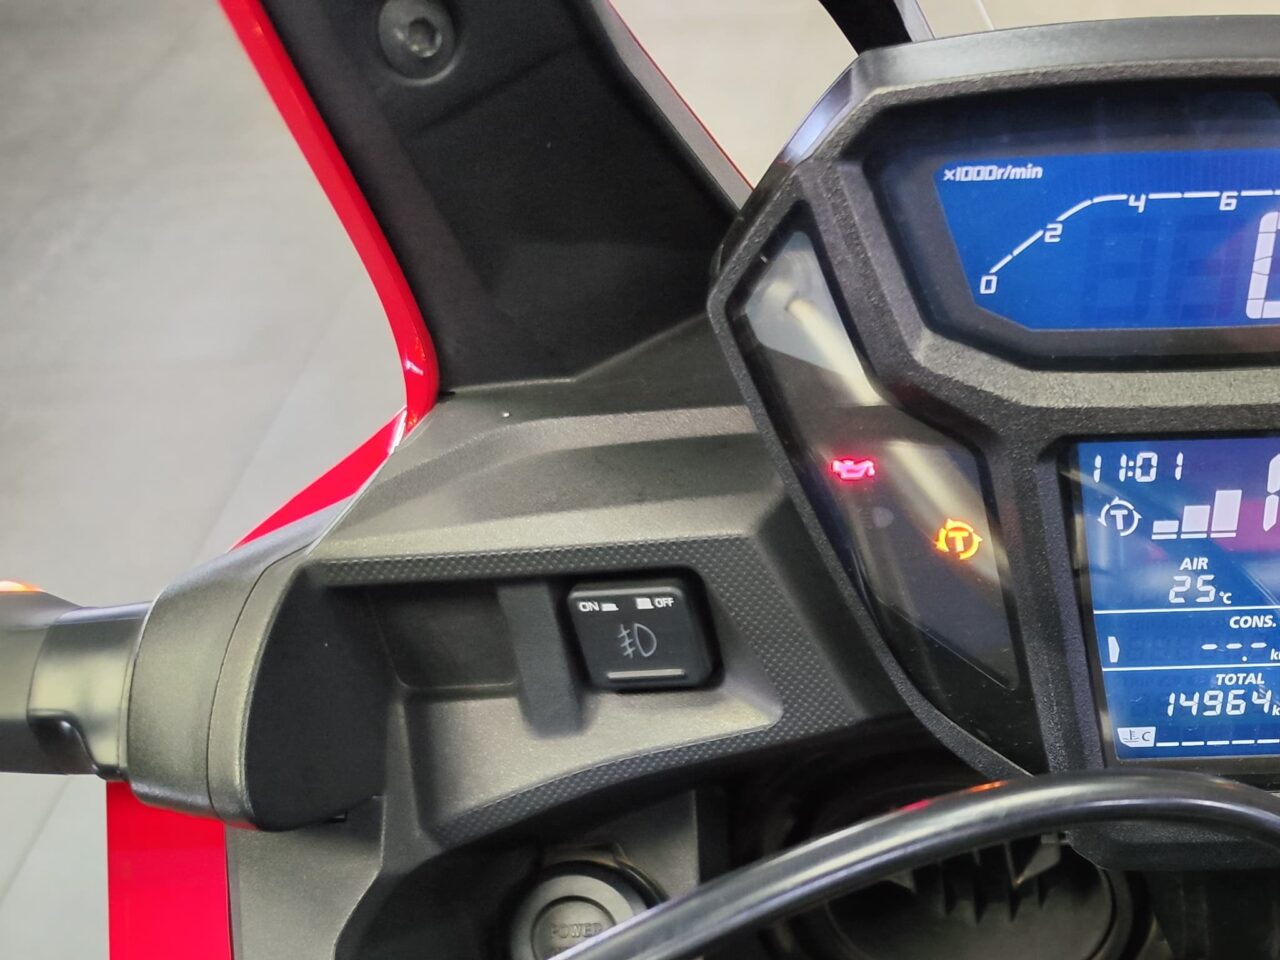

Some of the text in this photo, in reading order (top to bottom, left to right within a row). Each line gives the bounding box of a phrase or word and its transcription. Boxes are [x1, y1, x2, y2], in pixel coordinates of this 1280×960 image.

[1128, 195, 1146, 213] 4
[1219, 193, 1238, 211] 6
[1043, 223, 1063, 243] 2
[980, 275, 998, 294] 0
[1093, 452, 1184, 483] 11:01
[1180, 557, 1209, 570] AIR
[1168, 574, 1217, 604] 25
[578, 601, 600, 612] ON
[654, 598, 675, 608] OFF
[1229, 615, 1277, 629] CONS.
[1216, 673, 1265, 686] TOTAL
[1167, 690, 1272, 717] 14964
